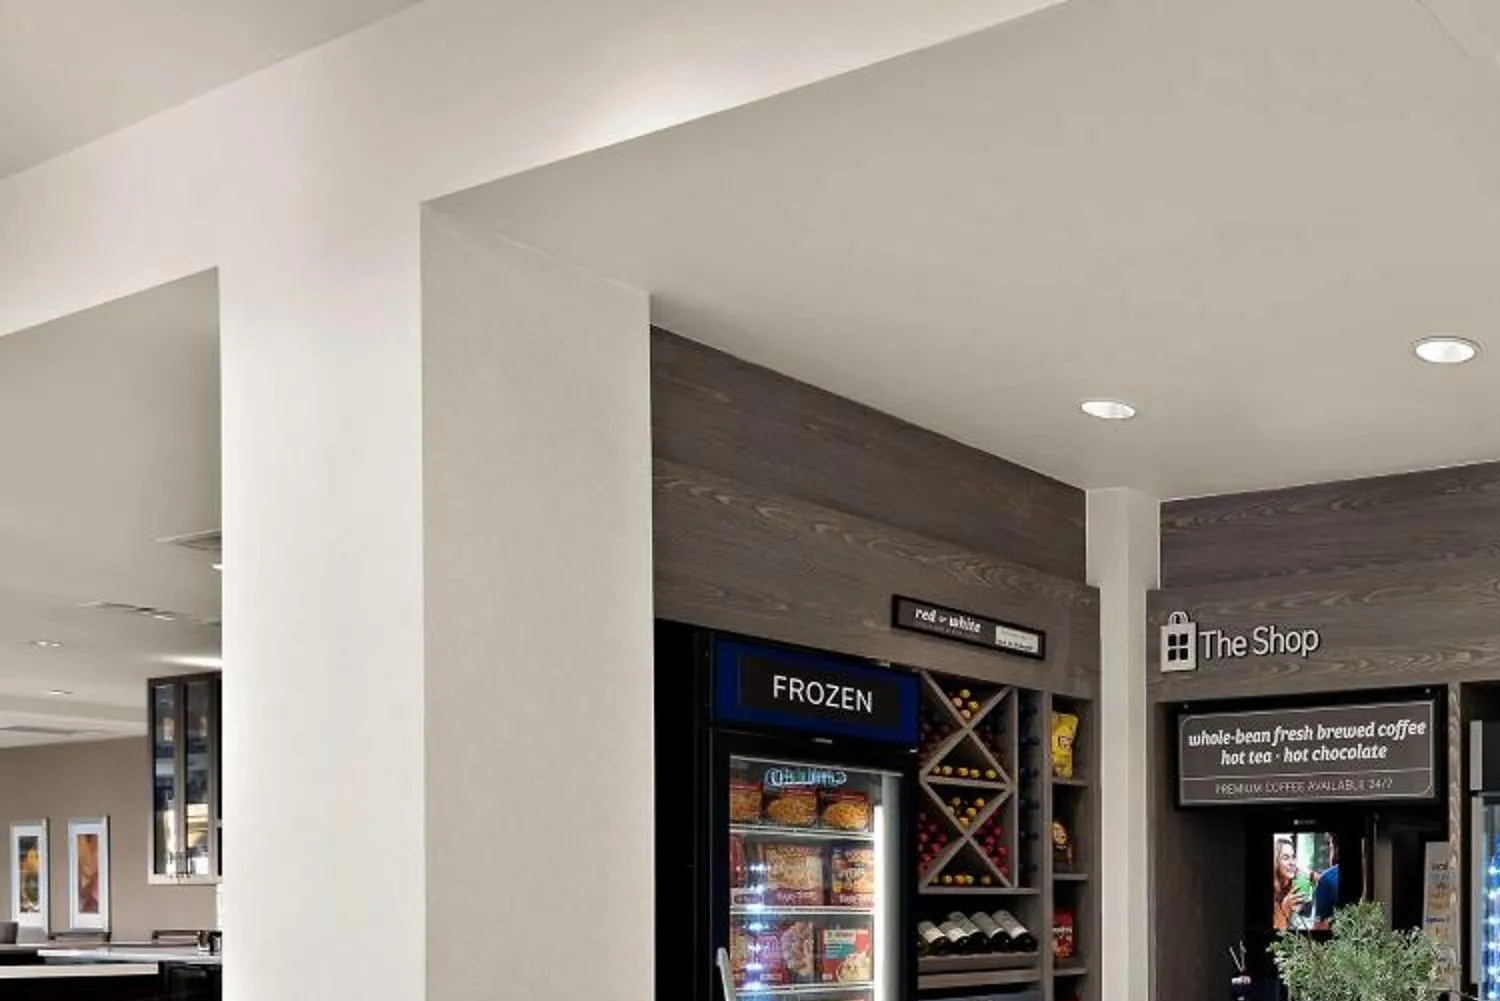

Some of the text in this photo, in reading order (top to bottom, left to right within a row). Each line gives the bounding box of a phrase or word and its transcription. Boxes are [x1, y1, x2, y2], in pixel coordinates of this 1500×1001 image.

[914, 608, 938, 623] red
[949, 615, 981, 633] white
[1199, 625, 1320, 659] The Shop
[772, 674, 873, 713] FROZEN
[1188, 719, 1427, 747] whole-bean fresh brewed coffee
[1221, 743, 1388, 766] hot tea hot chocolate
